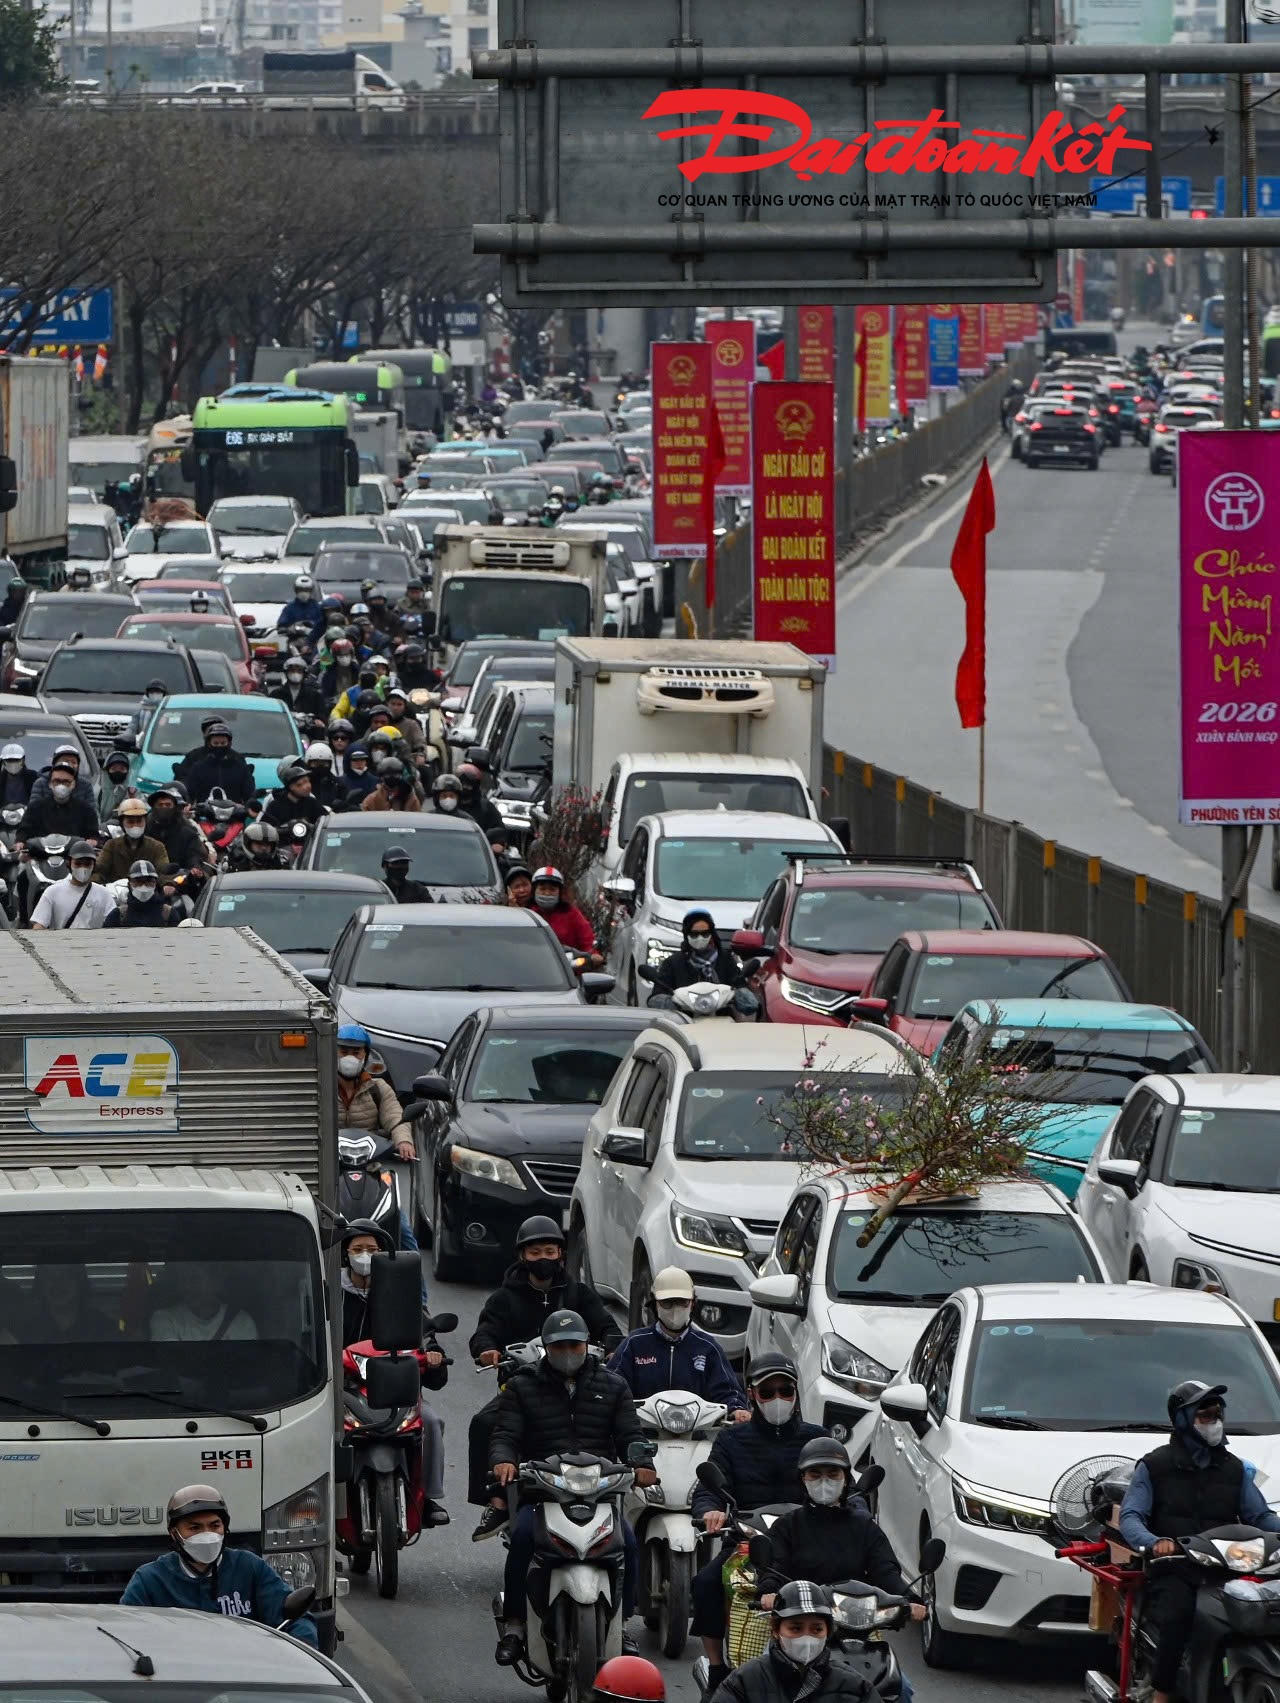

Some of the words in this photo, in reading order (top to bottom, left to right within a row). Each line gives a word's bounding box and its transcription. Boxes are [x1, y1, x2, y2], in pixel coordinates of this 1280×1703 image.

[763, 449, 789, 477] NGÀY
[791, 446, 809, 477] BẦU
[811, 446, 825, 477] CỬ
[765, 491, 777, 518] LÀ
[779, 490, 804, 519] NGÀY
[806, 490, 823, 524] HỘI
[762, 536, 779, 565] ĐẠI
[780, 531, 807, 560] ĐOÀN
[808, 529, 826, 560] KẾT
[1194, 549, 1276, 578] Chúc
[759, 573, 784, 601] TOÀN
[786, 573, 807, 601] DÂN
[808, 573, 830, 607] TỘC!
[1202, 583, 1273, 635] Mừng
[1208, 618, 1267, 650] Năm
[1213, 653, 1262, 687] Mới
[1198, 702, 1278, 723] 2026
[1196, 729, 1225, 743] XUÂN
[1191, 805, 1240, 821] PHƯỜNG
[1242, 805, 1265, 821] YÊN
[33, 1052, 171, 1098] ACE
[99, 1104, 164, 1119] Express
[201, 1449, 252, 1461] QKR
[201, 1459, 253, 1470] 210
[65, 1506, 163, 1526] ISUZU
